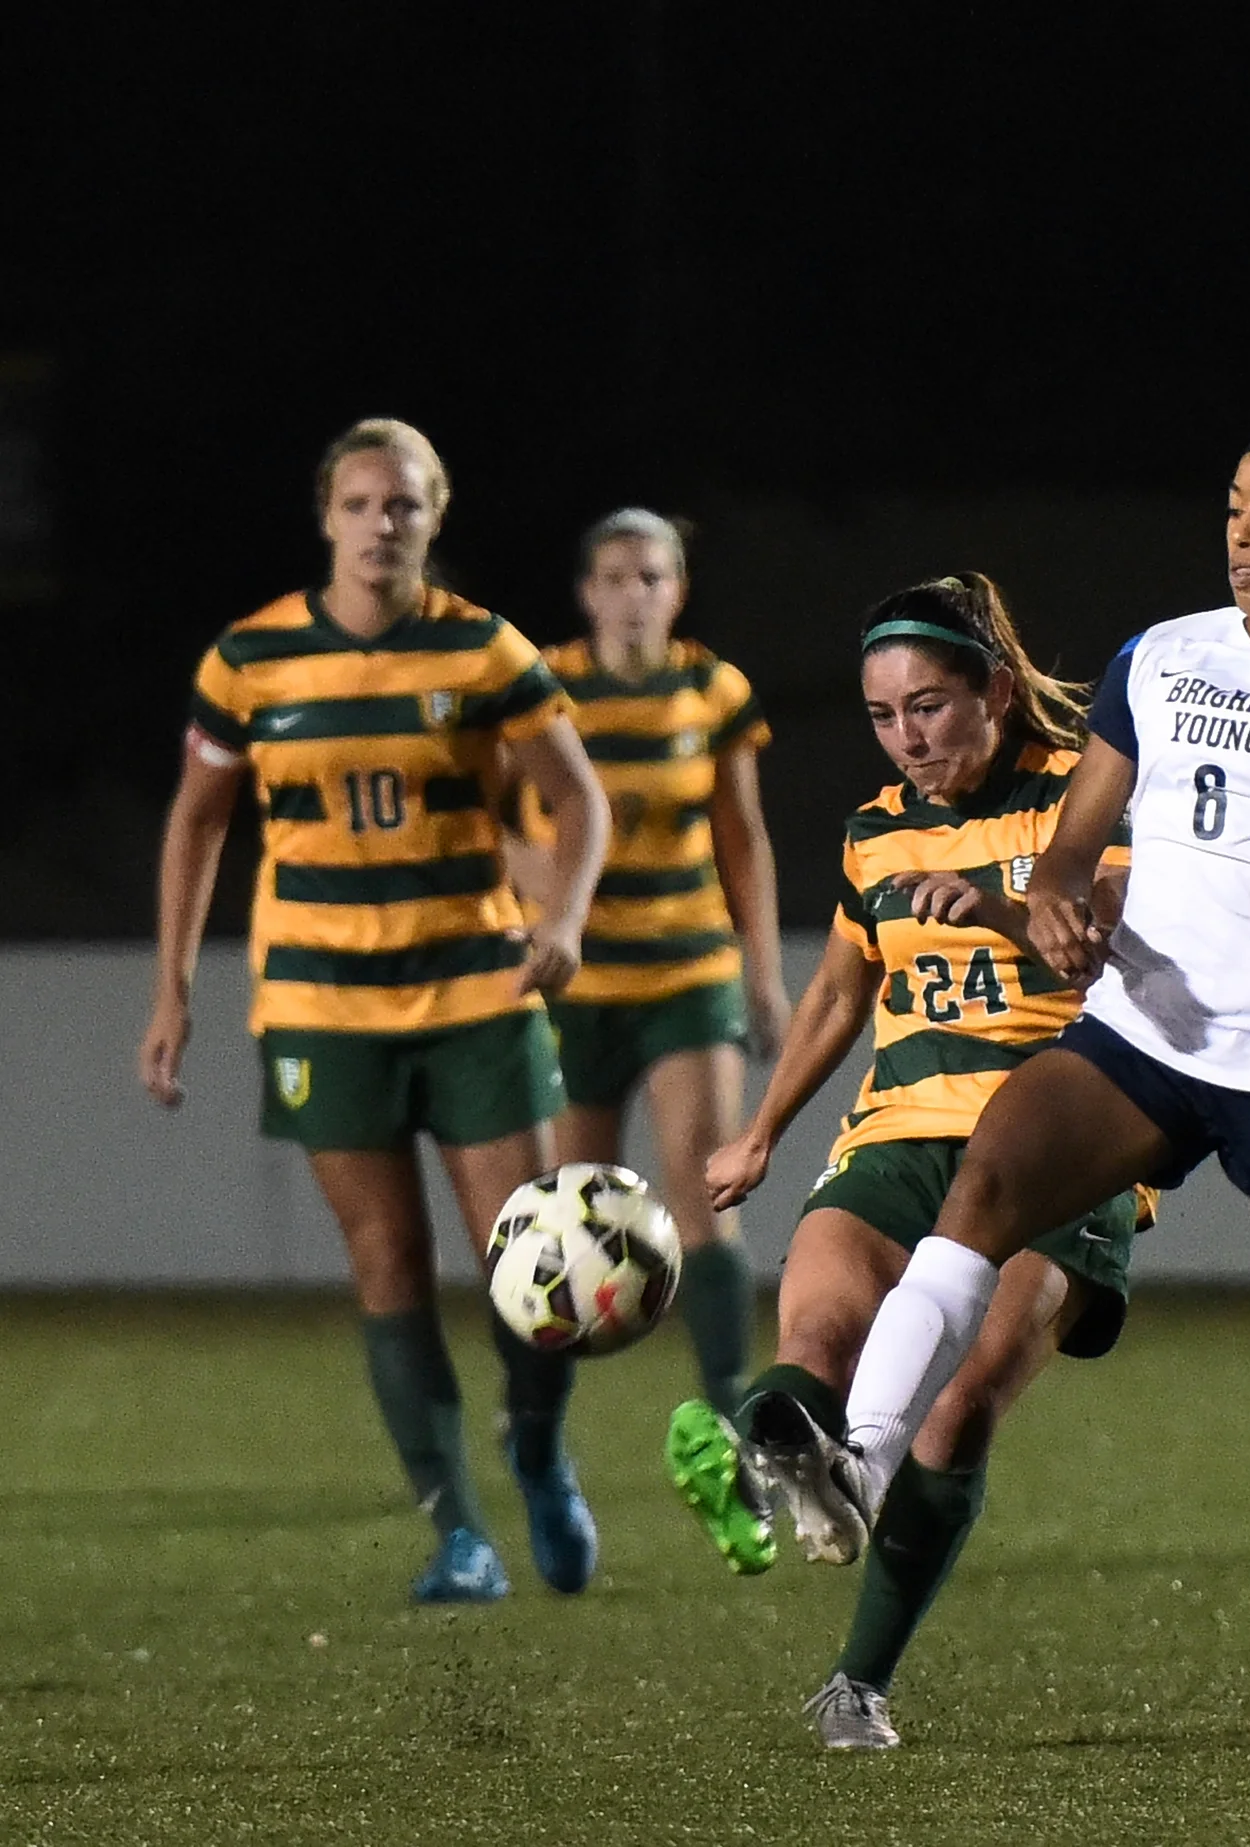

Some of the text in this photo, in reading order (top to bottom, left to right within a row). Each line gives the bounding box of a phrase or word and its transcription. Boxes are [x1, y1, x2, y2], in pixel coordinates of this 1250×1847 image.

[345, 768, 405, 833] 10
[1193, 763, 1228, 841] 8
[915, 946, 1010, 1024] 24
